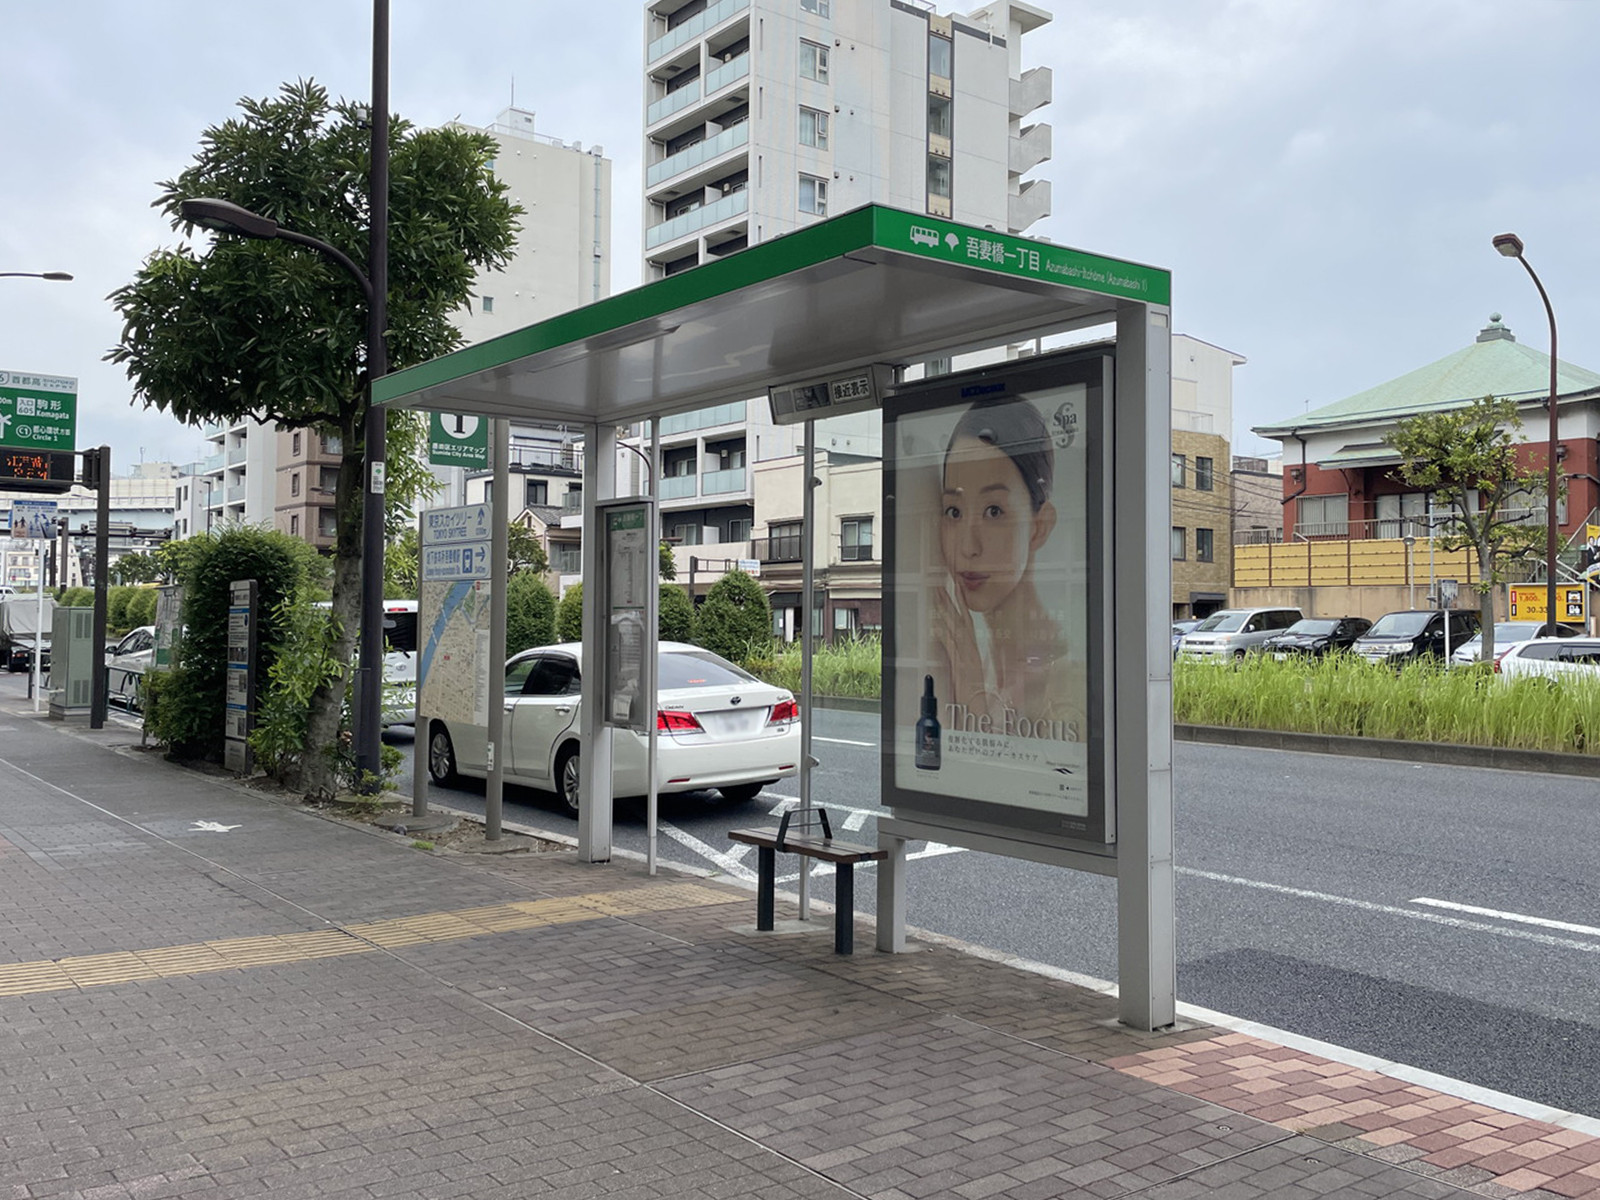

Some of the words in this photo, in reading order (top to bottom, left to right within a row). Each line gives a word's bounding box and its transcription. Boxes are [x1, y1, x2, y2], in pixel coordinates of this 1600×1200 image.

[966, 236, 1041, 272] 吾妻橋一丁目
[12, 375, 41, 386] 首都高
[834, 379, 868, 399] 接近表示
[18, 406, 34, 415] 605
[36, 398, 62, 411] 駒形
[36, 410, 70, 421] Komagata
[1052, 411, 1078, 432] Spa
[32, 433, 52, 442] Circle
[428, 511, 473, 529] 東京スカイツリー
[433, 528, 448, 540] TOKYO
[945, 702, 992, 735] The
[1002, 706, 1080, 743] Focus
